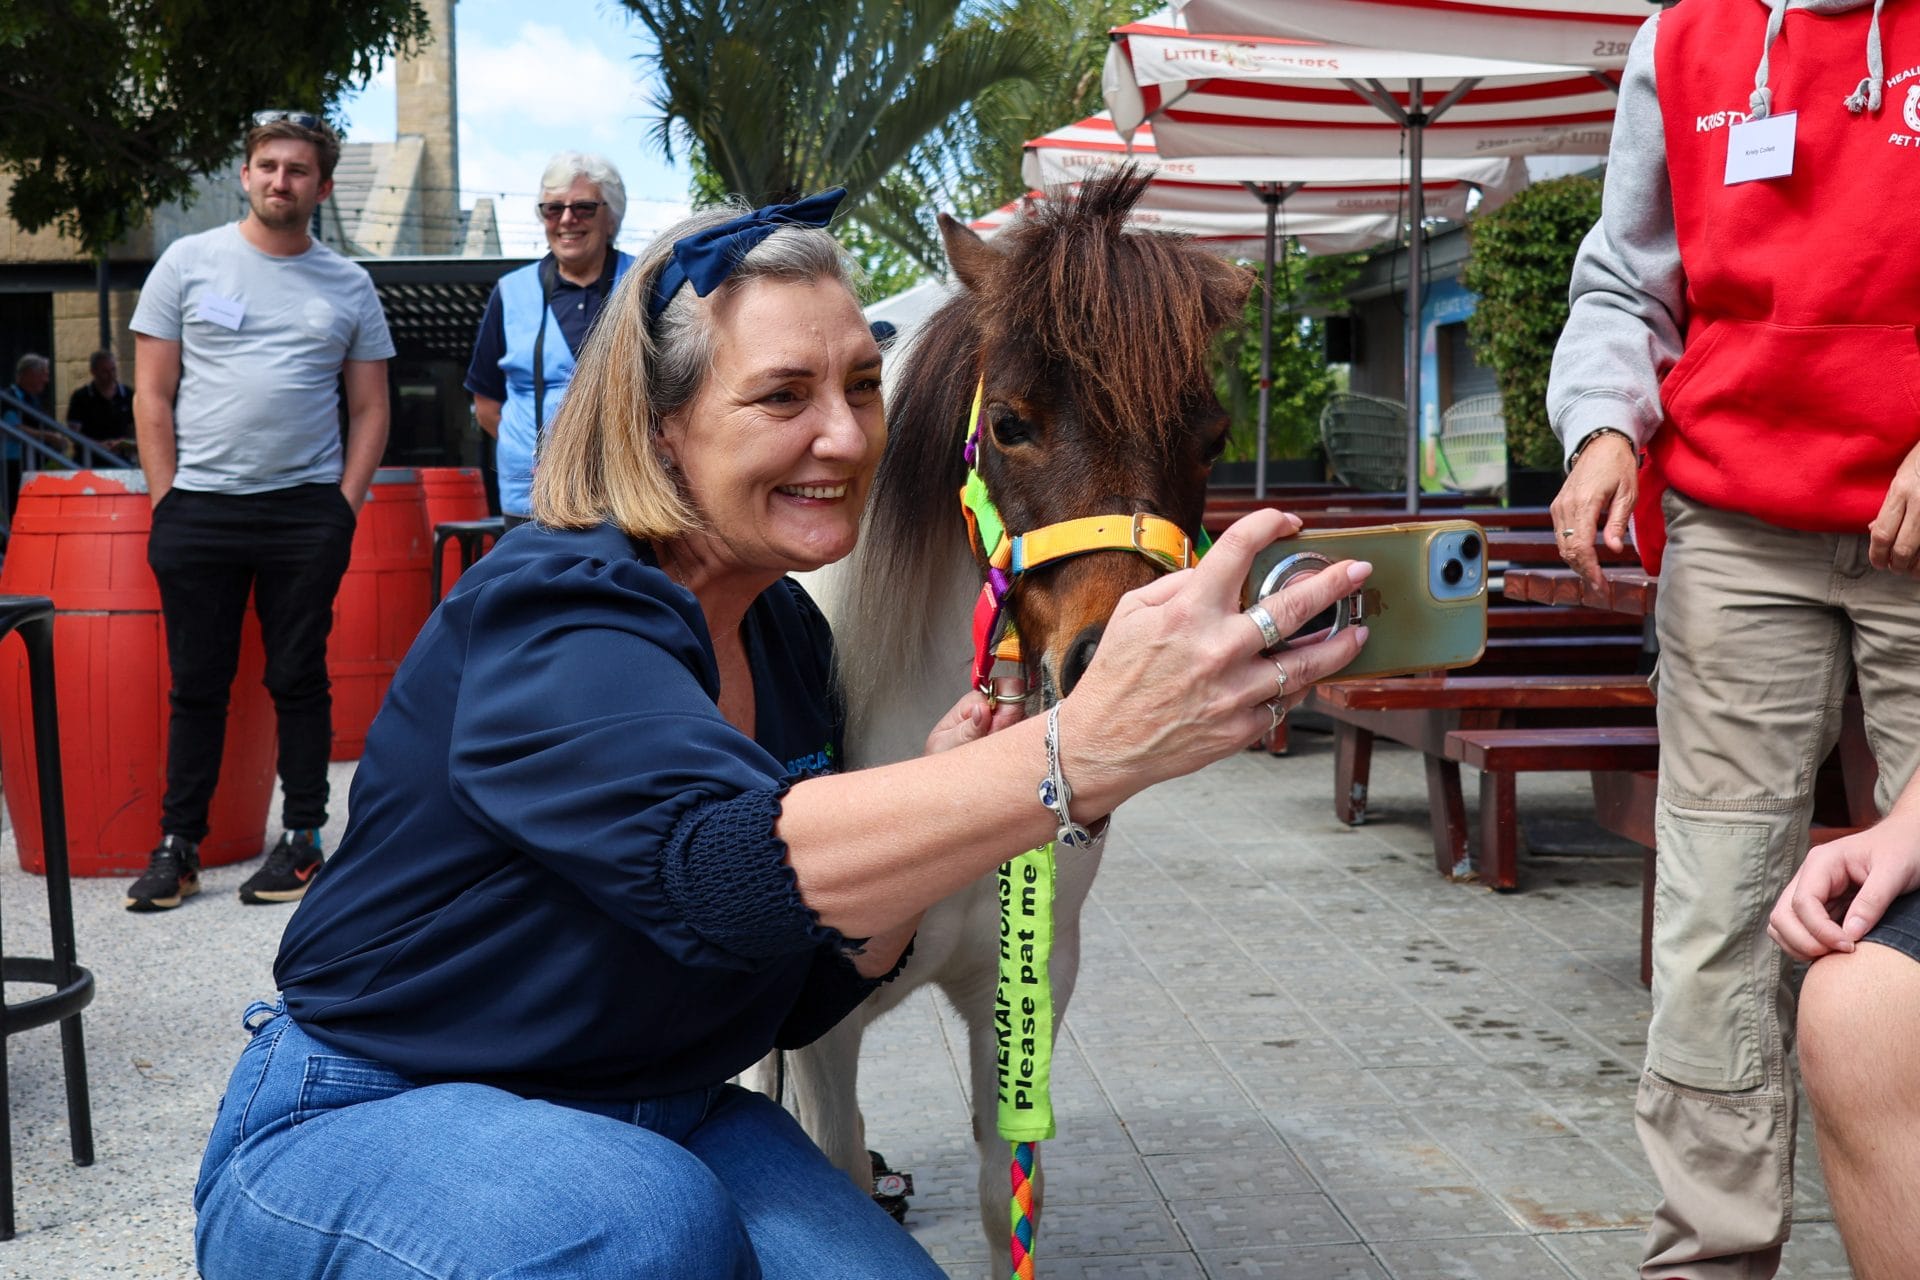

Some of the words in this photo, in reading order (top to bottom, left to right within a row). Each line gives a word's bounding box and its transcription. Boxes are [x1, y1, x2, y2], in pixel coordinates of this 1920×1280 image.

[1163, 48, 1220, 62] LITTLE
[1888, 133, 1912, 147] PET
[1021, 864, 1037, 917] me
[1017, 929, 1039, 985] pat
[1015, 995, 1036, 1110] Please
